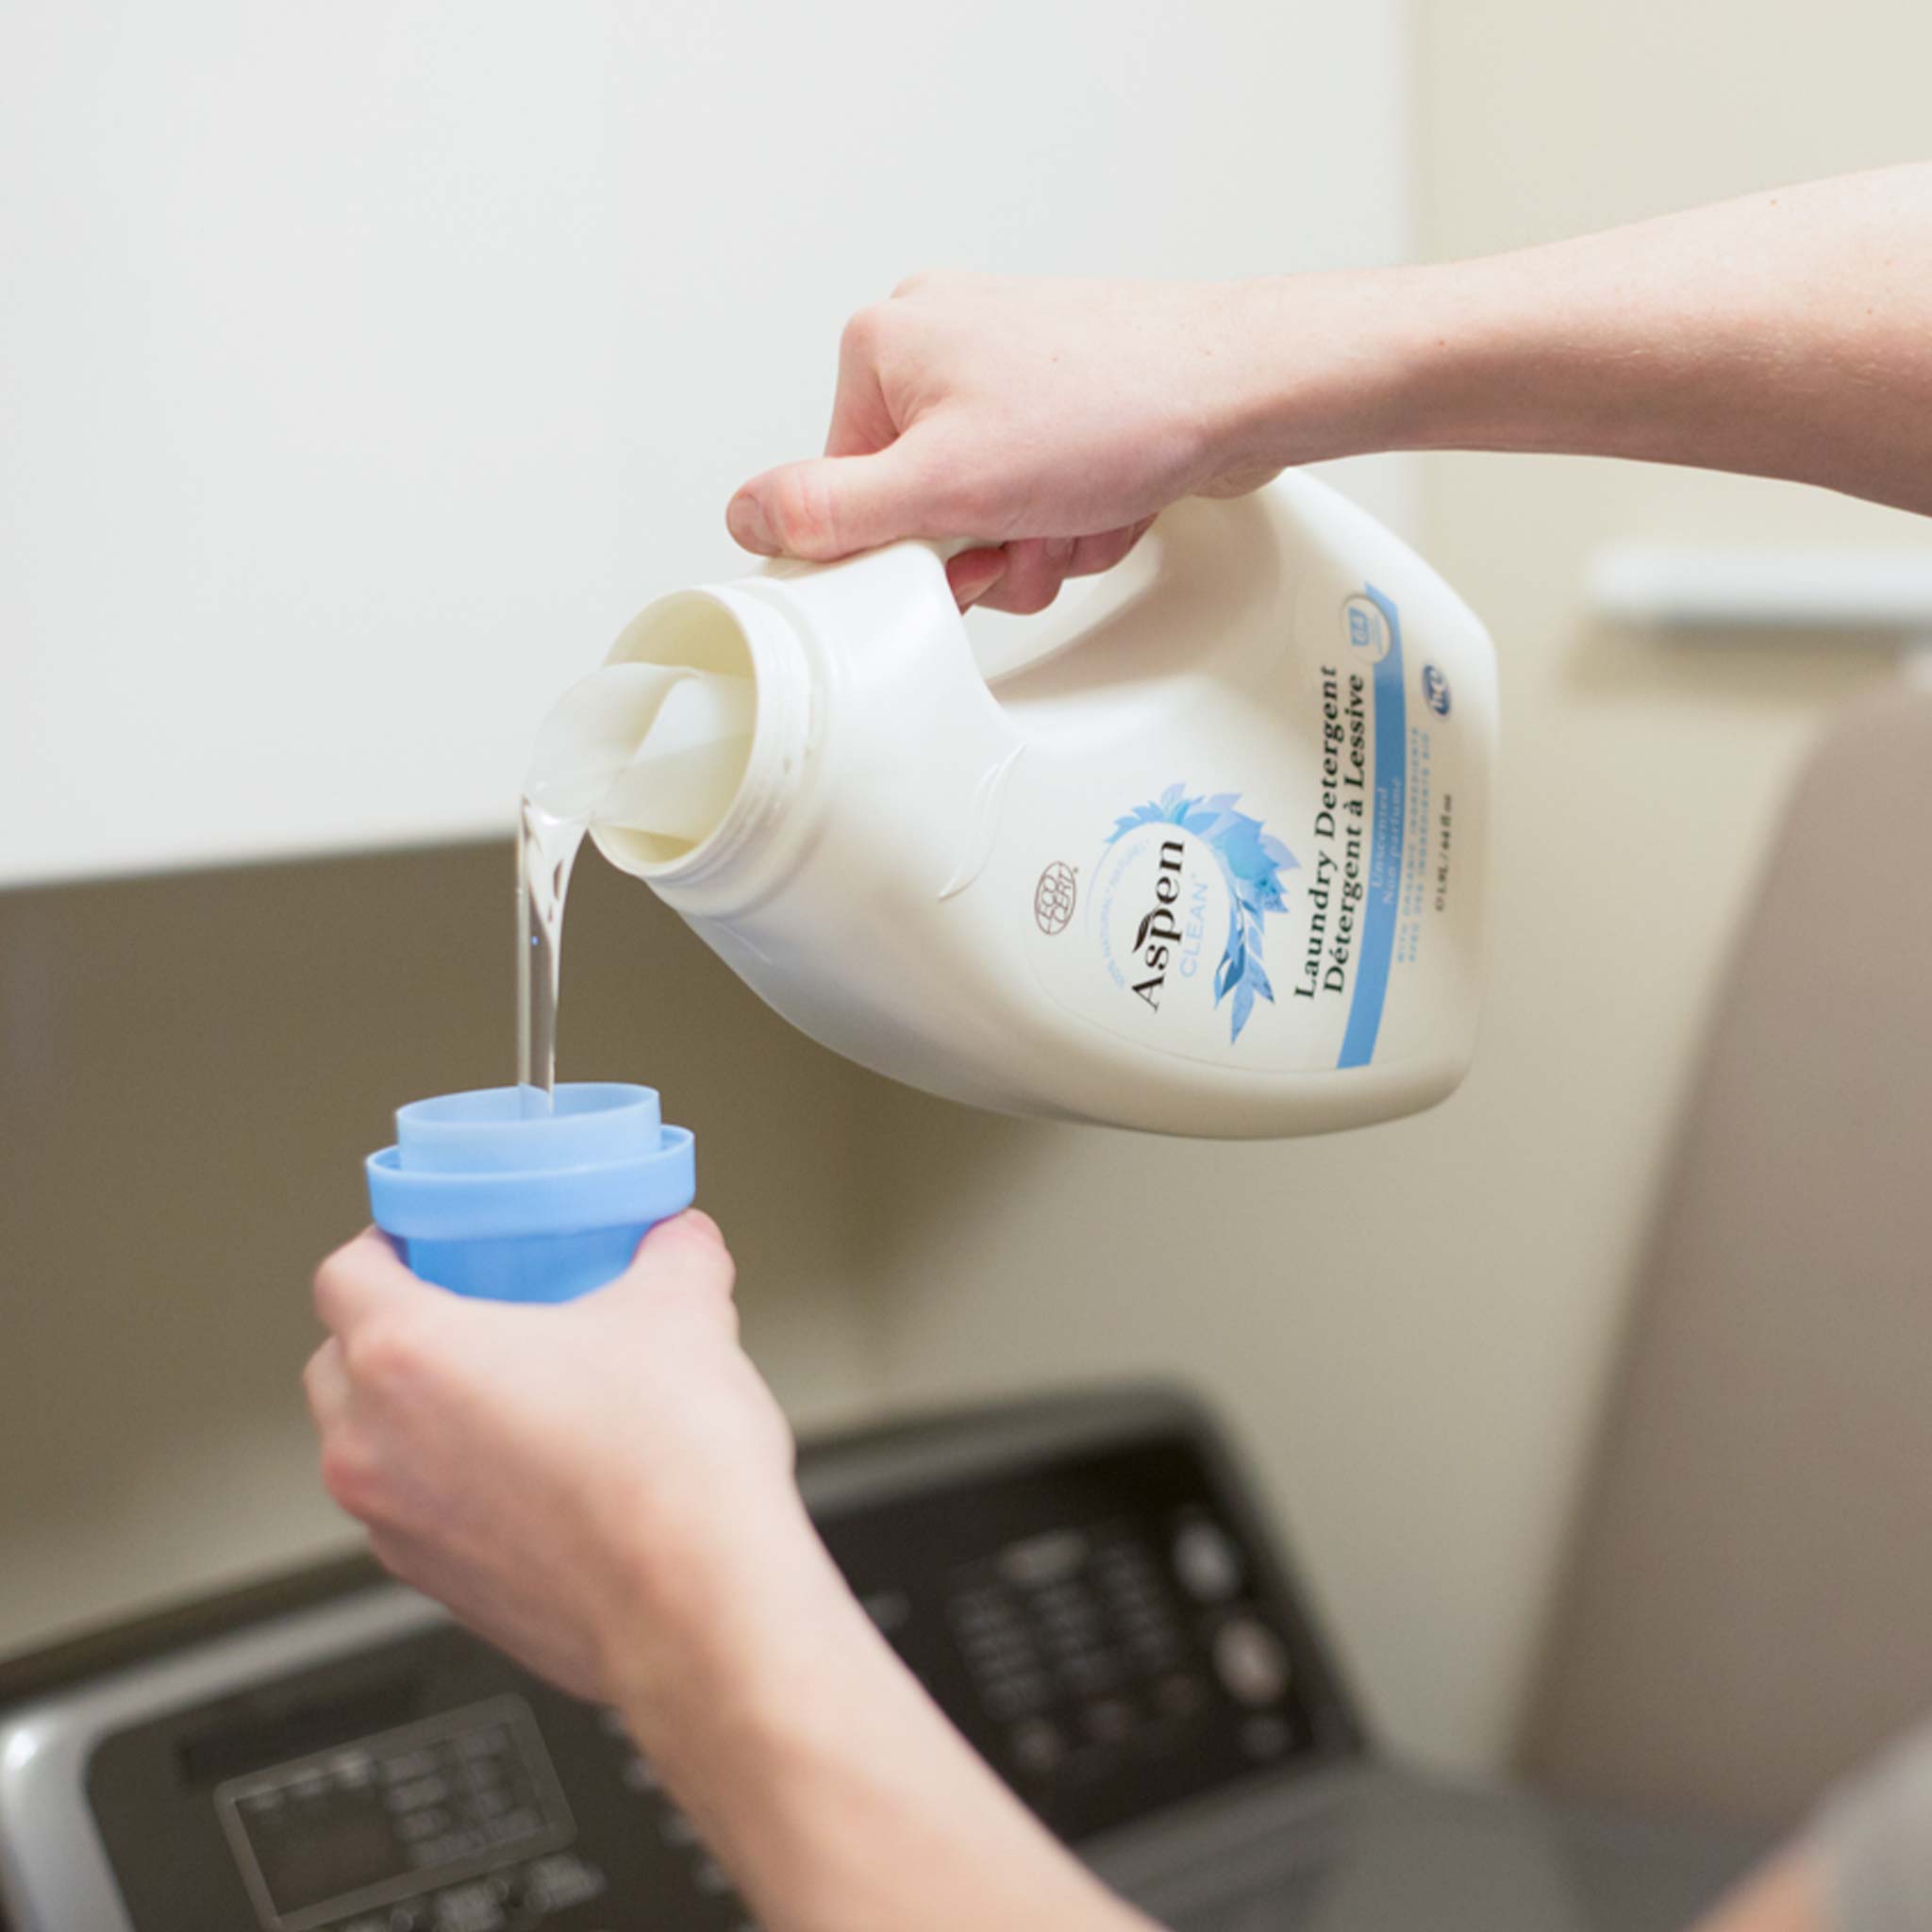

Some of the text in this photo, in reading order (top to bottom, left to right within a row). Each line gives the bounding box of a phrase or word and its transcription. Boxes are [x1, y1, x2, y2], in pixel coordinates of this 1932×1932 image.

[1293, 665, 1344, 1001] Laundry Detergent
[1323, 674, 1365, 994] Détergent à Lessive
[1370, 786, 1390, 889] Unscented
[1038, 874, 1058, 921] ECO
[1054, 873, 1073, 924] CERT
[1131, 840, 1185, 1014] Aspen
[1179, 881, 1208, 978] CLEAN
